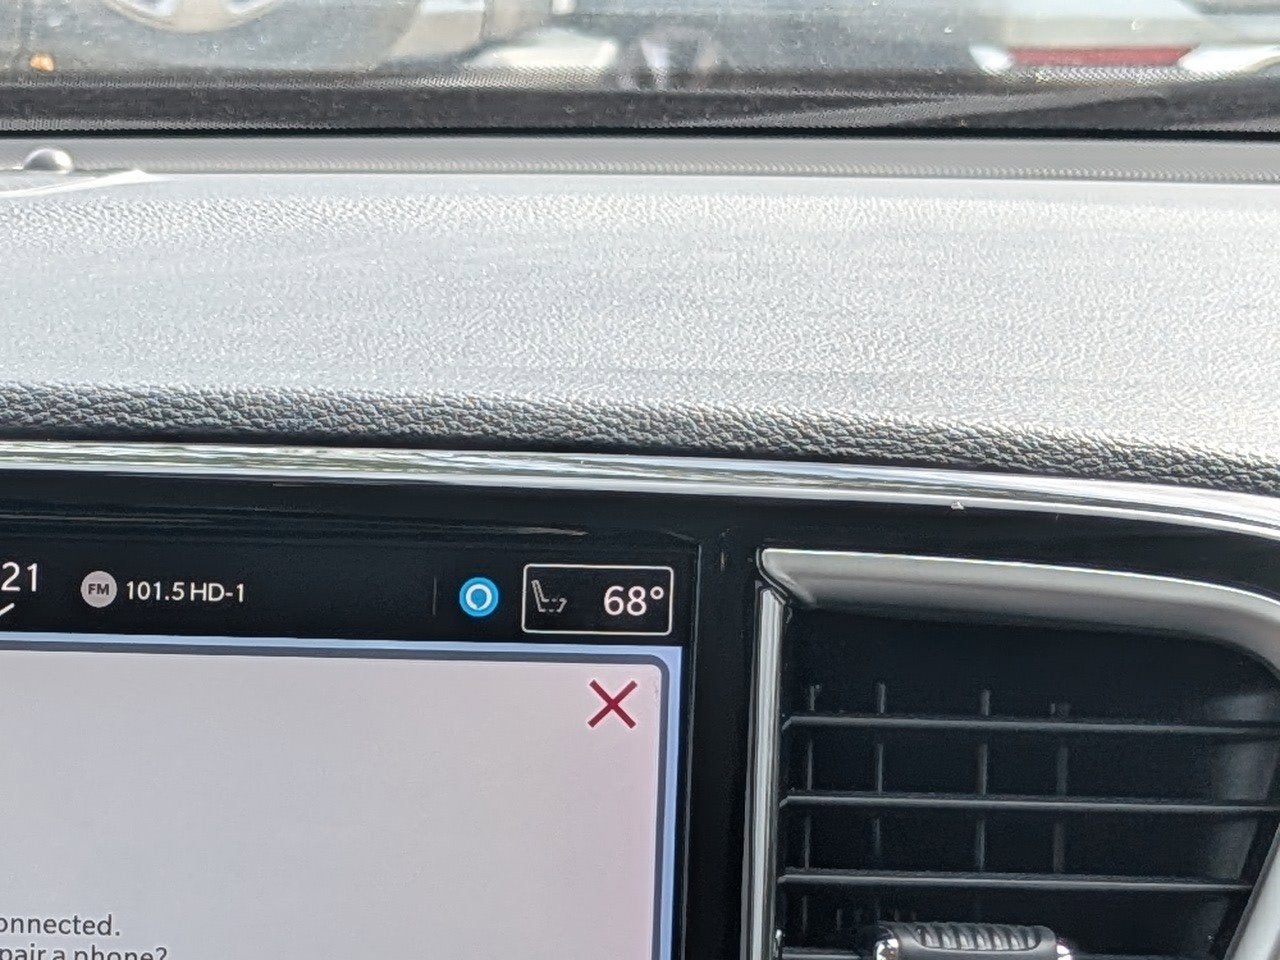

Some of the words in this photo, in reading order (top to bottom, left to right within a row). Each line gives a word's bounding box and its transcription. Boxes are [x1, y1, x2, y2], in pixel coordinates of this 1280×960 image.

[87, 583, 111, 597] FM
[126, 580, 186, 601] 101.5
[189, 582, 246, 603] HD-1
